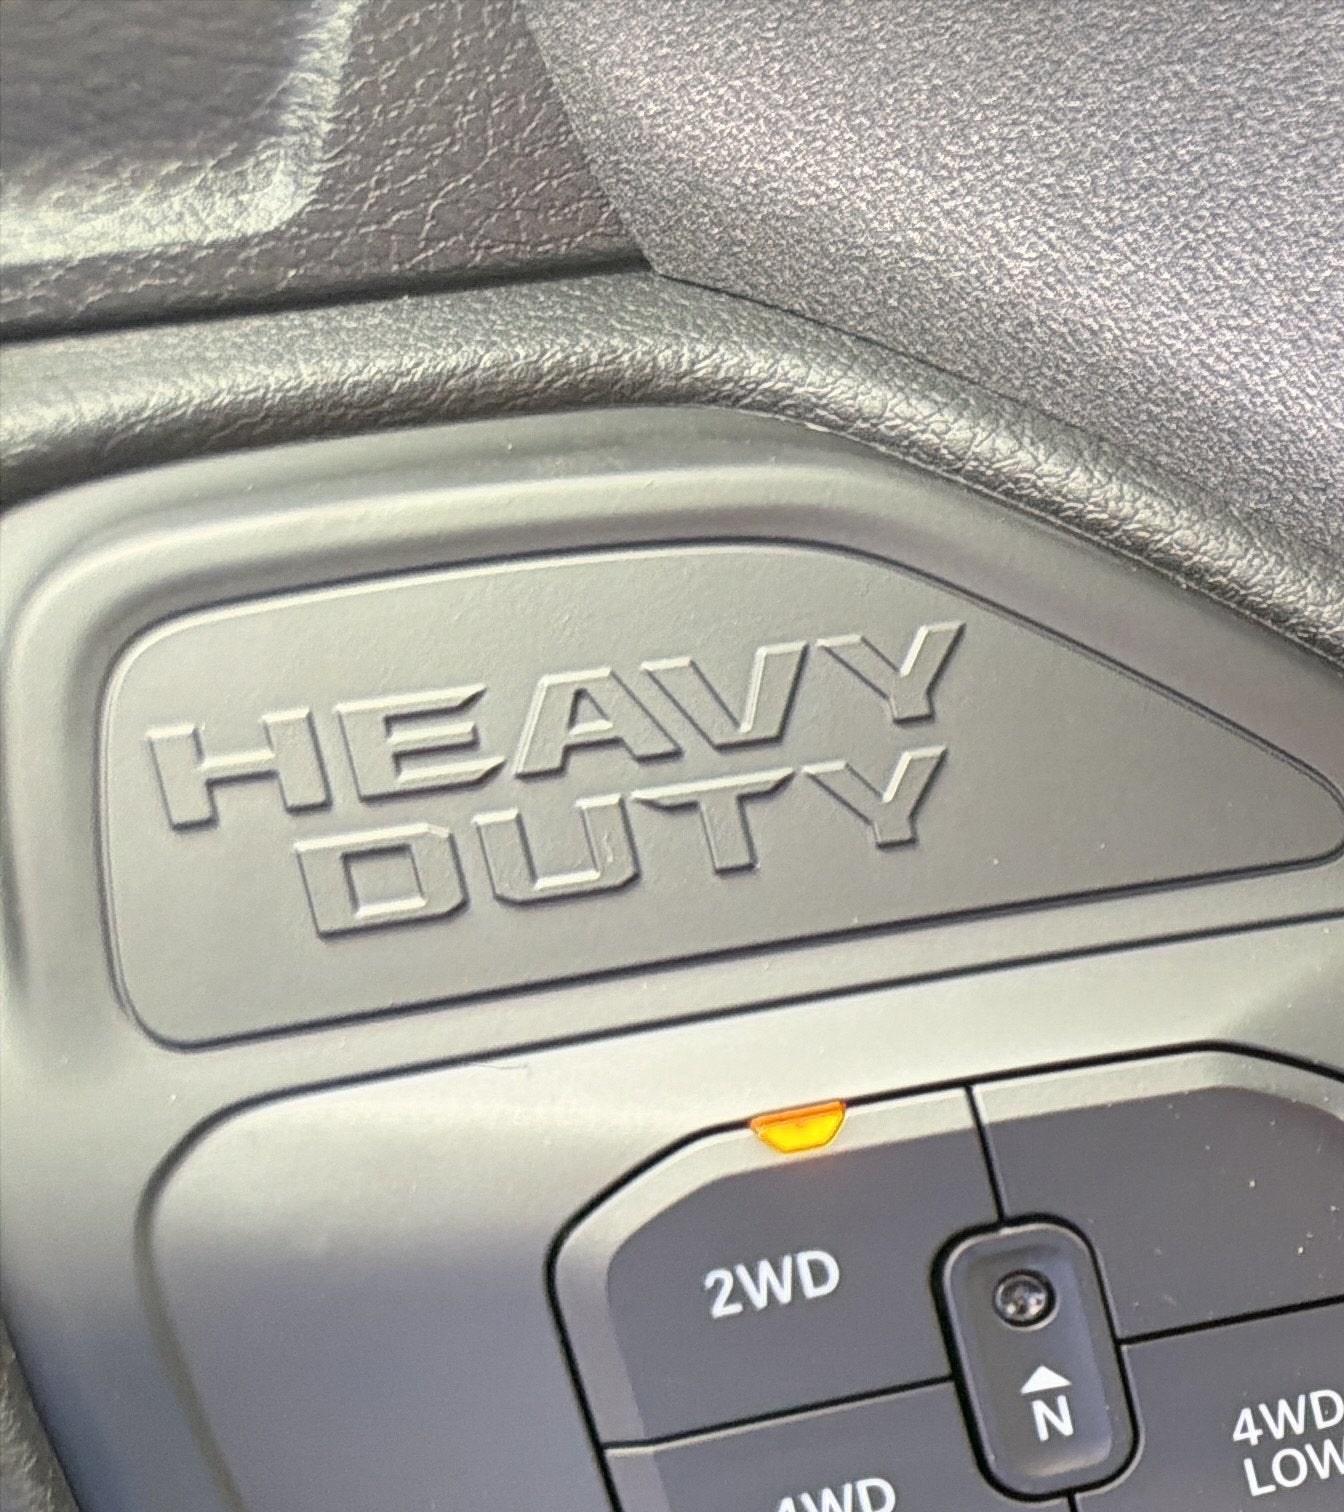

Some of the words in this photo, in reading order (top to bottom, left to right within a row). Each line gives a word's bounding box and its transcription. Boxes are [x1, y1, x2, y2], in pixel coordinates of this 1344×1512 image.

[145, 620, 966, 831] HEAVY
[292, 744, 948, 939] DUTY
[703, 1249, 841, 1320] 2WD
[1031, 1395, 1076, 1443] N
